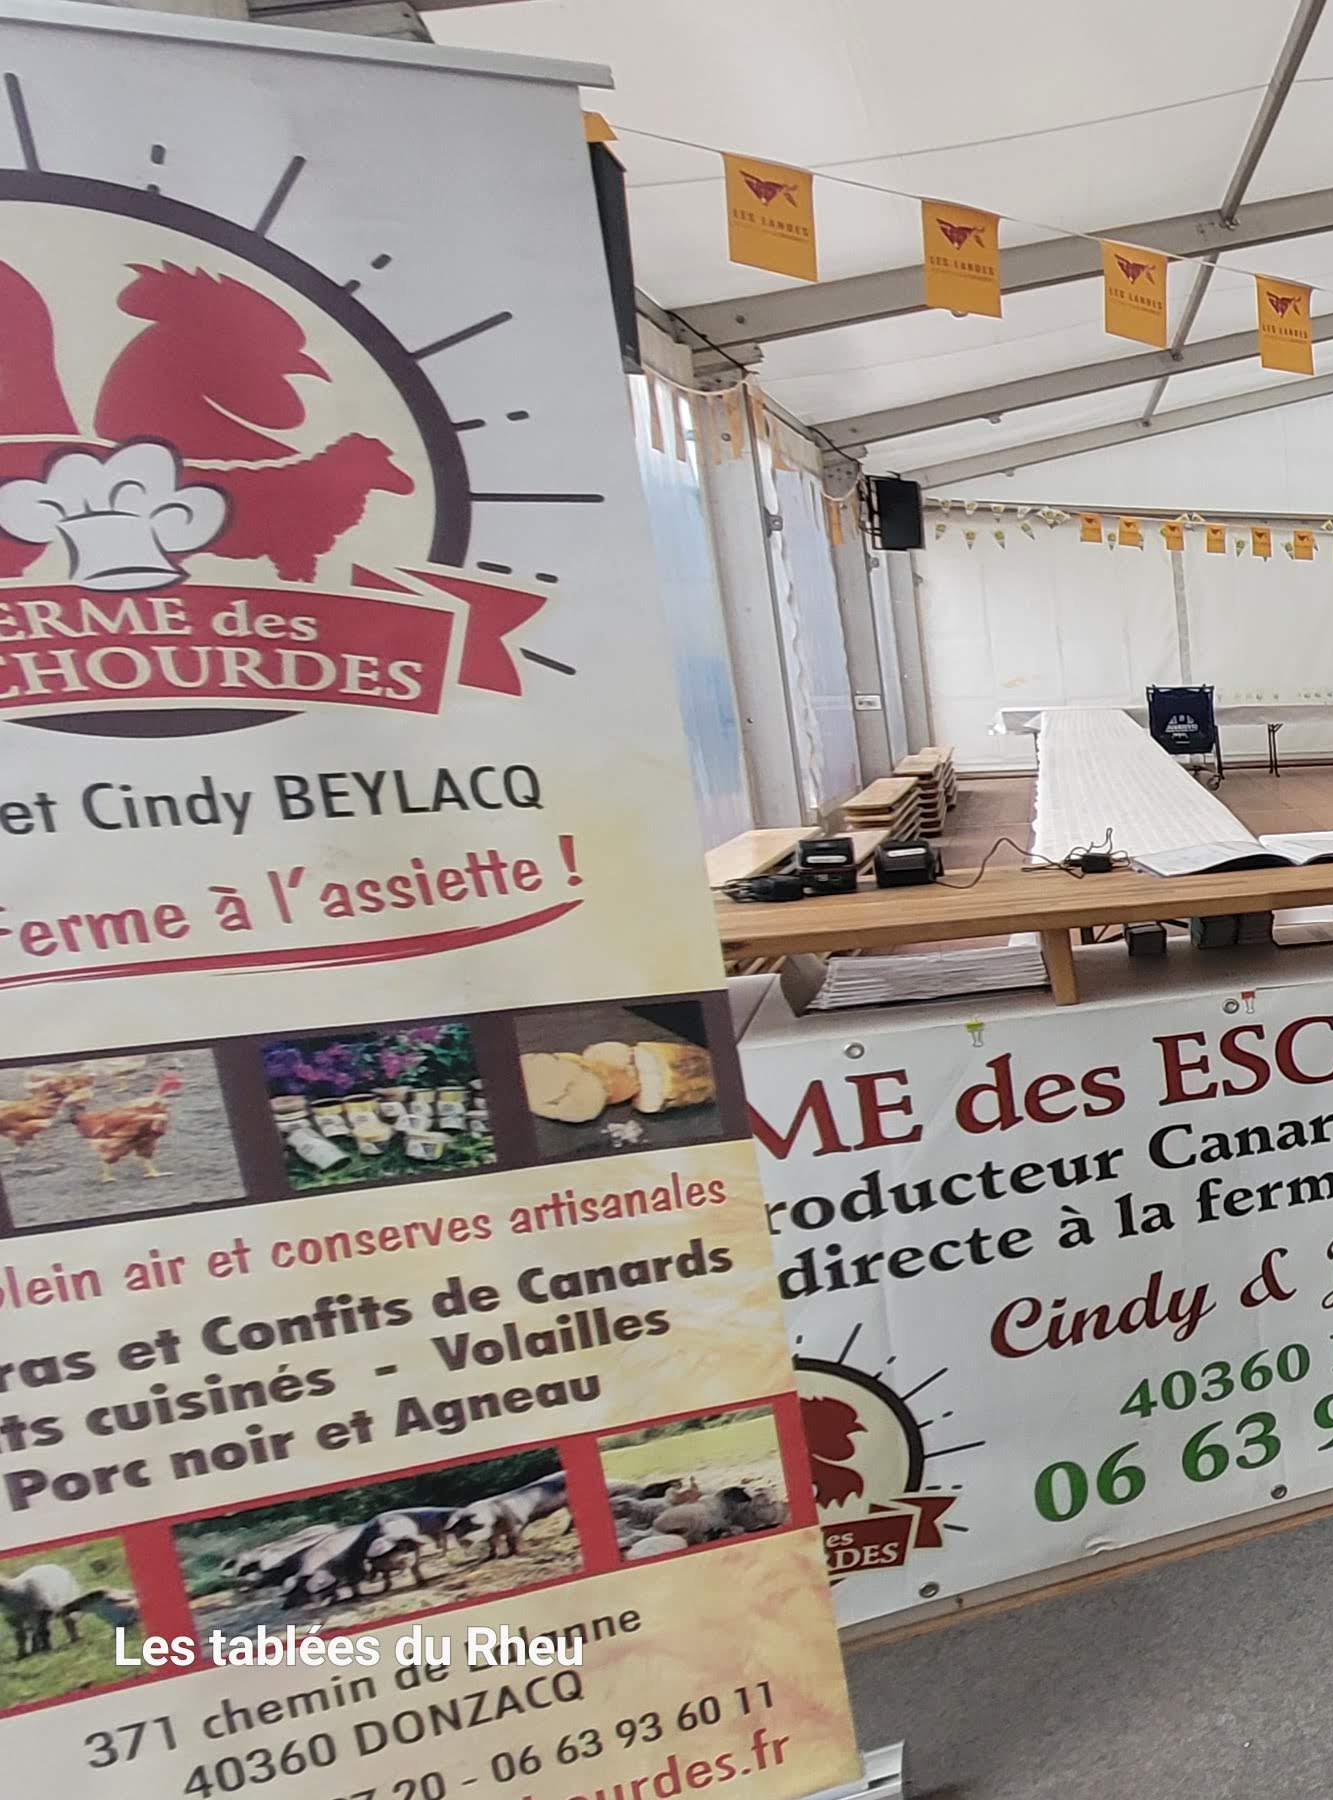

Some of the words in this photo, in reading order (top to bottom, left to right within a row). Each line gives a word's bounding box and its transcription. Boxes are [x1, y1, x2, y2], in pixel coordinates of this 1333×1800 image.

[210, 601, 318, 641] des
[0, 793, 57, 834] et
[82, 776, 252, 835] Cindy
[274, 765, 544, 821] BEYLACQ
[0, 903, 190, 957] erme
[208, 885, 253, 931] à
[267, 849, 543, 924] l'assiette
[558, 835, 585, 887] !
[955, 1053, 1125, 1134] des
[0, 1263, 102, 1309] lein
[124, 1249, 185, 1291] air
[207, 1239, 252, 1281] et
[270, 1211, 493, 1269] conserves
[508, 1172, 728, 1236] artisanales
[766, 1147, 1124, 1234] roducteur
[777, 1220, 1033, 1300] directe
[1058, 1205, 1095, 1249] à
[1114, 1192, 1174, 1238] la
[118, 1329, 181, 1370] et
[201, 1293, 413, 1357] Confits
[432, 1272, 501, 1320] de
[517, 1237, 733, 1302] Canards
[989, 1270, 1216, 1359] Cindy
[1240, 1247, 1297, 1307] &
[85, 1362, 336, 1437] cuisinés
[430, 1305, 671, 1372] Volailles
[1119, 1343, 1310, 1419] 40360
[4, 1459, 152, 1512] Porc
[170, 1434, 296, 1486] noir
[316, 1409, 374, 1450] et
[395, 1372, 601, 1438] Agneau
[1033, 1441, 1146, 1523] 06
[1181, 1410, 1280, 1482] 63
[832, 1542, 899, 1570] DES
[82, 1714, 180, 1770] 371
[201, 1674, 377, 1741] chemin
[184, 1732, 336, 1800] 40360
[354, 1669, 584, 1757] DONZACQ
[491, 1745, 542, 1783] 06
[556, 1729, 603, 1765] 63
[615, 1712, 663, 1749] 93
[677, 1695, 721, 1732] 60
[734, 1681, 773, 1715] 11
